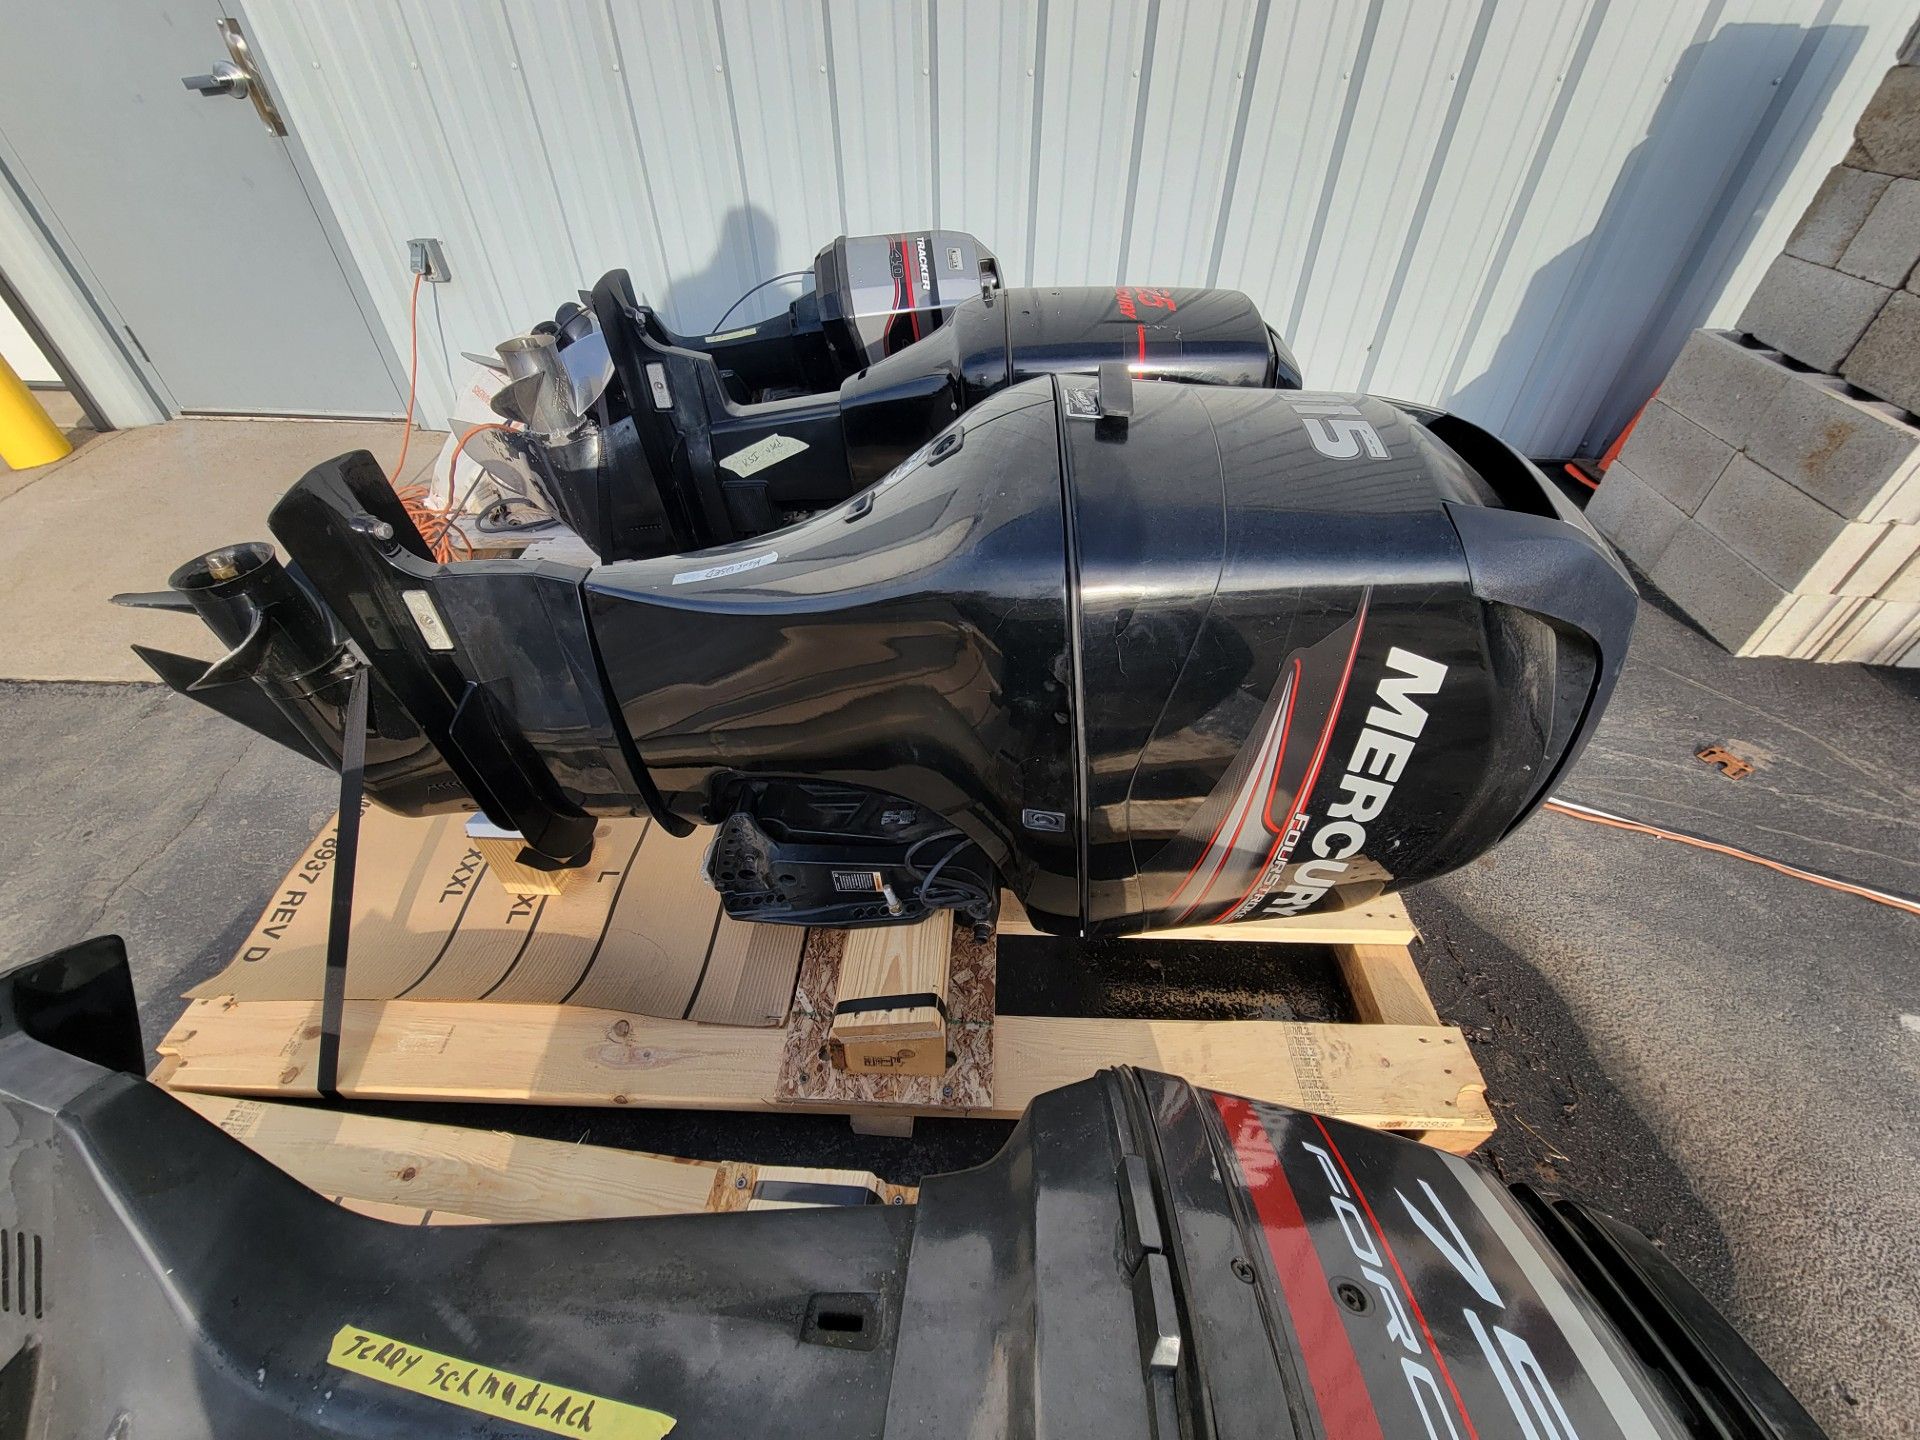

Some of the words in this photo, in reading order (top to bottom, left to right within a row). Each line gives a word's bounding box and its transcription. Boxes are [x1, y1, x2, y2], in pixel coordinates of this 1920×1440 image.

[890, 249, 904, 279] 40
[917, 237, 930, 290] TRACKER
[1262, 646, 1448, 917] MERCURY
[298, 828, 338, 884] 8937
[439, 847, 483, 903] XXXL
[597, 871, 620, 882] L
[1234, 812, 1310, 918] FOURSTROKE
[262, 890, 307, 940] REV
[243, 946, 270, 962] D
[1302, 1141, 1459, 1440] FORC
[1394, 1178, 1579, 1440] 75
